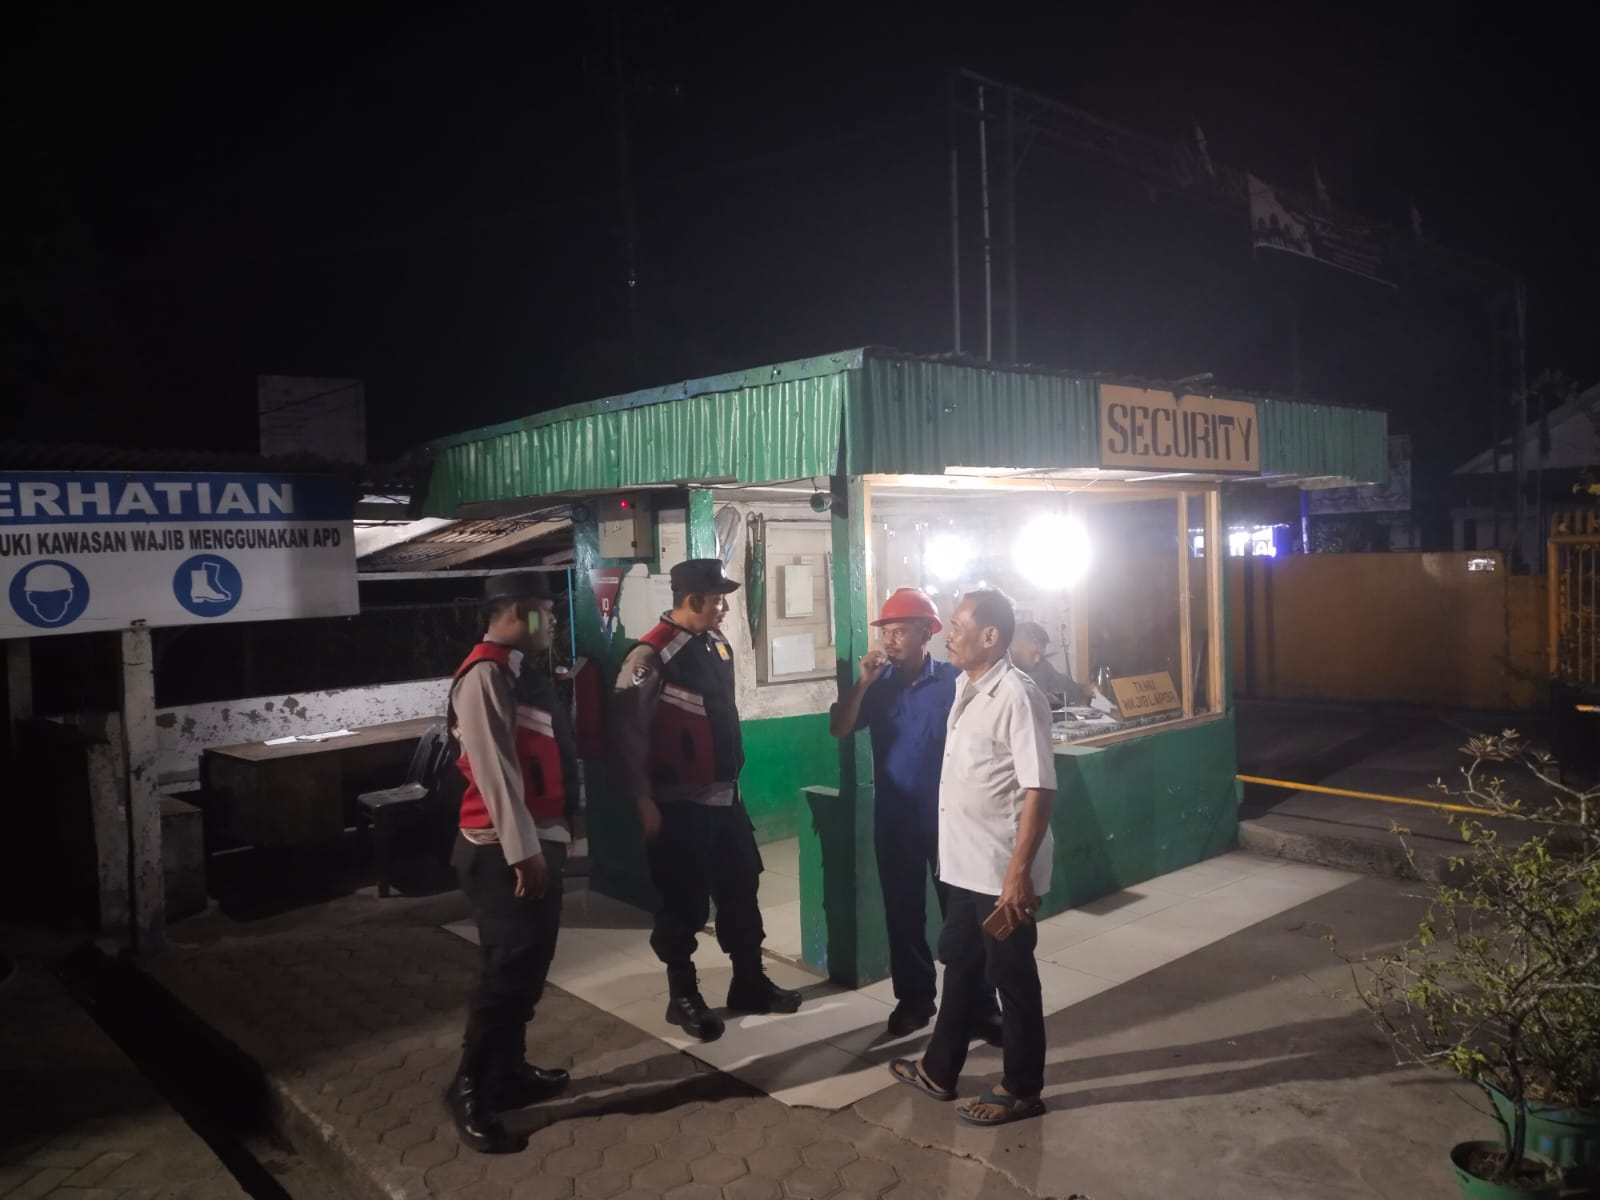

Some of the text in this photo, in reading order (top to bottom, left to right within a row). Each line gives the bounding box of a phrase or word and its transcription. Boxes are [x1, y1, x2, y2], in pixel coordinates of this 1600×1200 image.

[1108, 403, 1252, 461] SECURITY
[37, 531, 126, 555] KAWASAN
[131, 529, 184, 551] WAJIB
[189, 528, 309, 550] MENGGUNAKAN
[313, 528, 341, 547] APD
